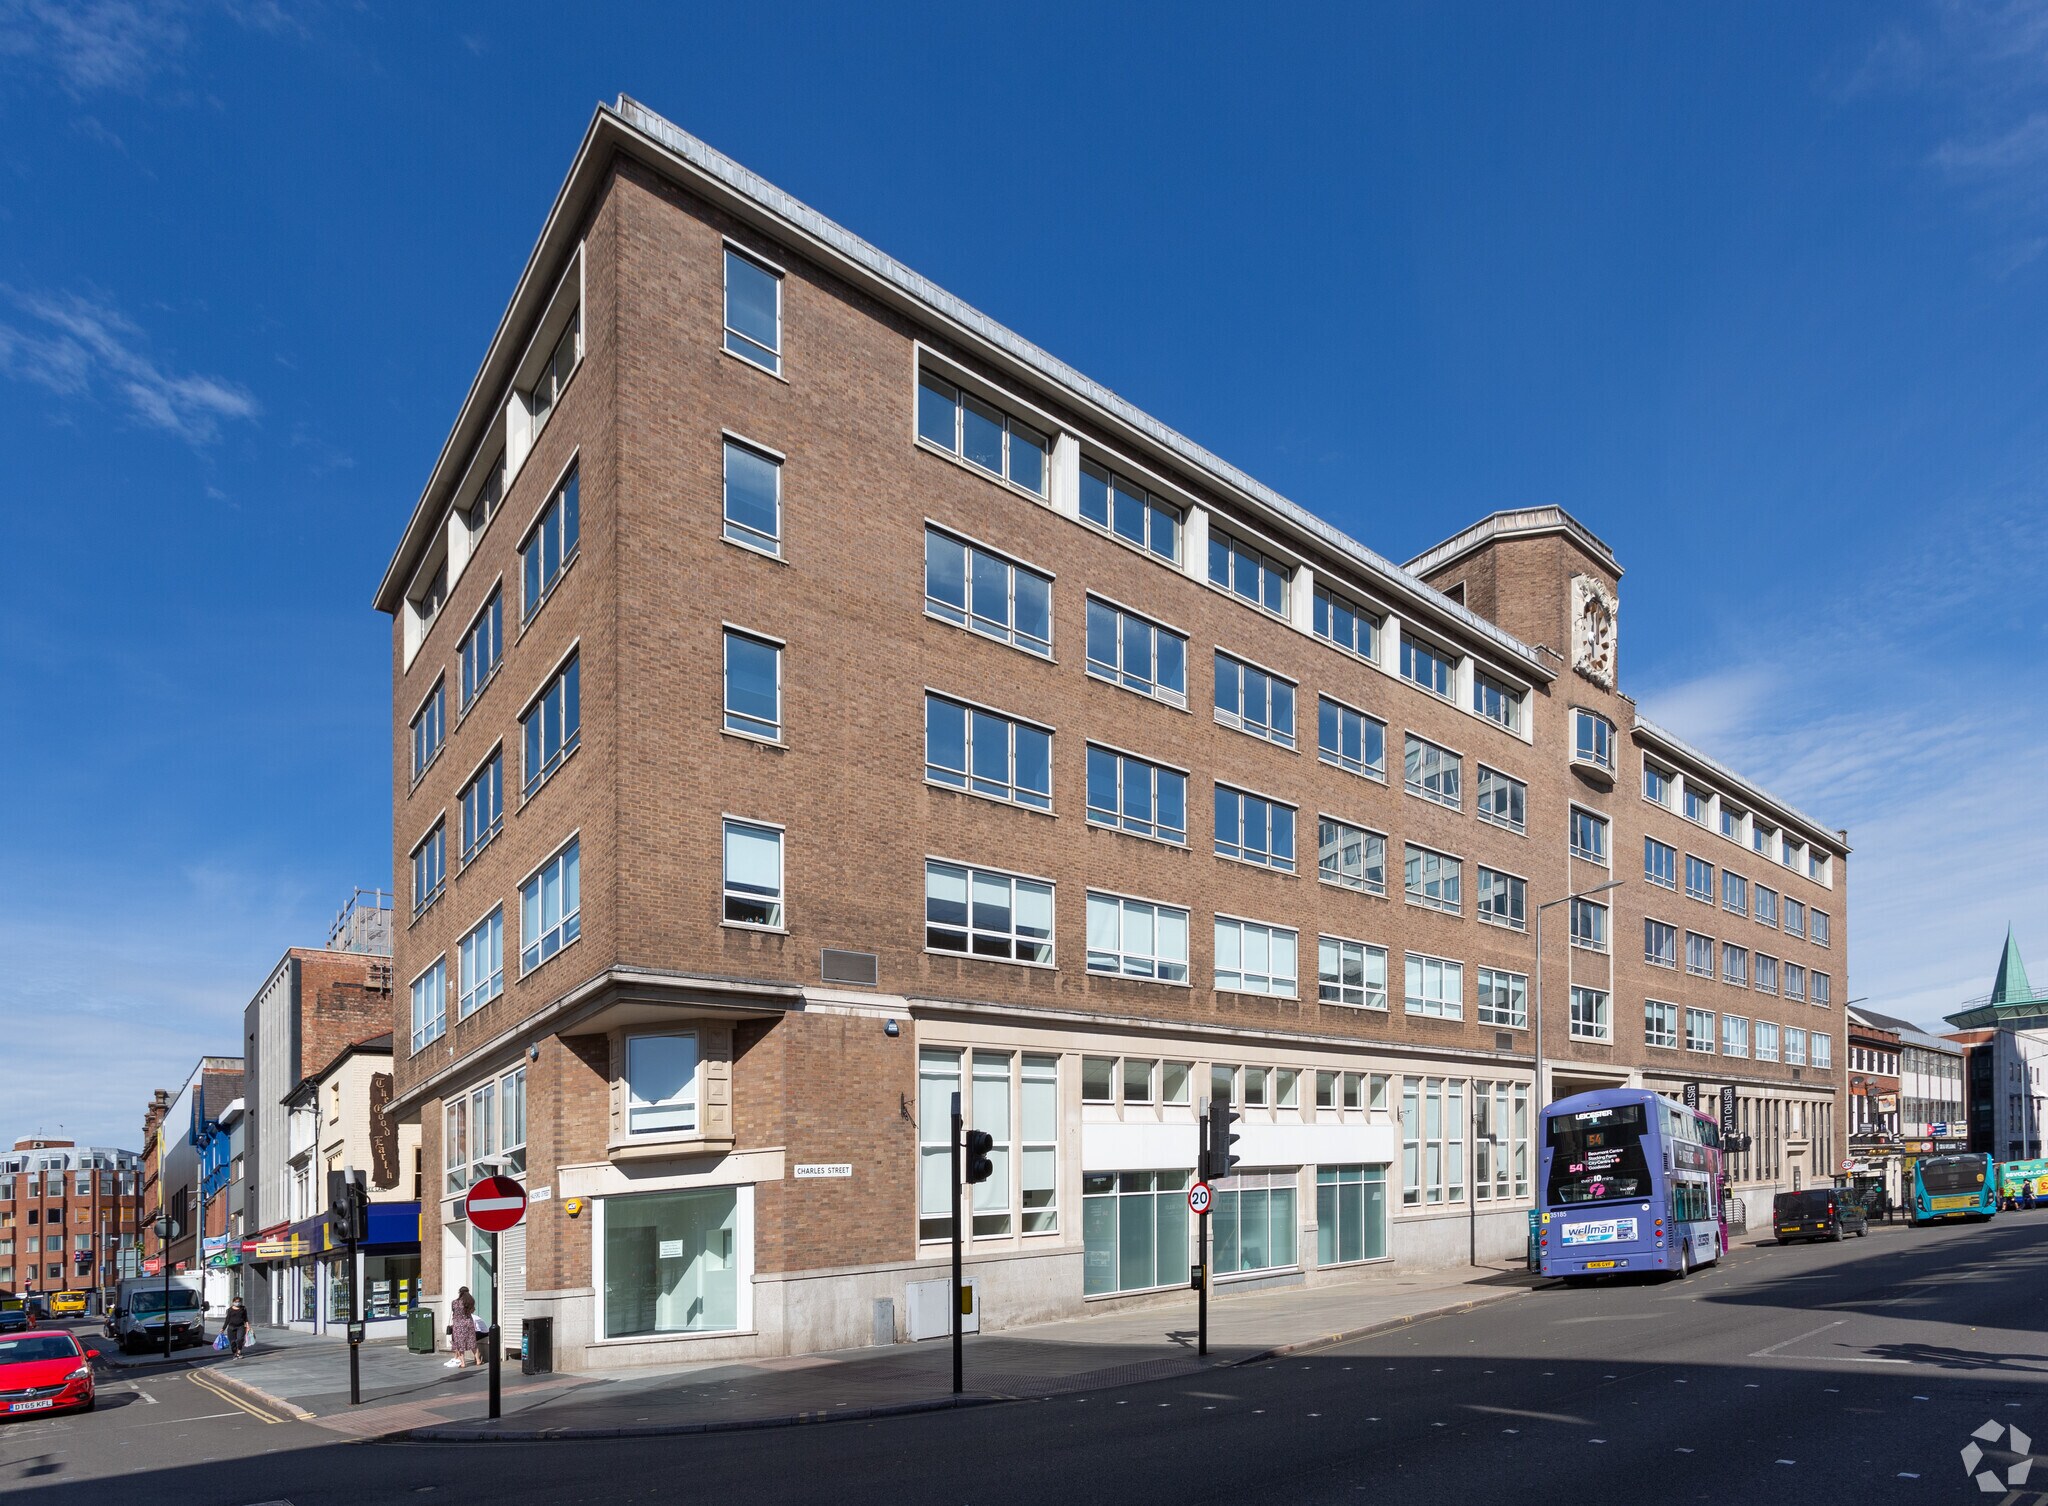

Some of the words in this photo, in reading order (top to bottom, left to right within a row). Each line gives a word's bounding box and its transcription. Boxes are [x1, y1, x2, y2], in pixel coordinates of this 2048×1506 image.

[375, 1077, 390, 1104] The
[1687, 1085, 1696, 1109] BISTR
[1723, 1088, 1733, 1114] BISTRO
[373, 1103, 391, 1136] Good
[1575, 1109, 1613, 1120] LEICESTER
[1724, 1115, 1733, 1131] LIVE
[1588, 1133, 1602, 1146] 54
[373, 1135, 393, 1179] Earth
[797, 1167, 825, 1175] CHARLES
[827, 1166, 850, 1174] STREET
[1569, 1163, 1583, 1173] 54
[1593, 1174, 1602, 1182] 10
[1191, 1191, 1208, 1205] 20
[1550, 1211, 1567, 1219] 35185
[1568, 1224, 1615, 1236] wellman
[14, 1402, 35, 1411] DT65
